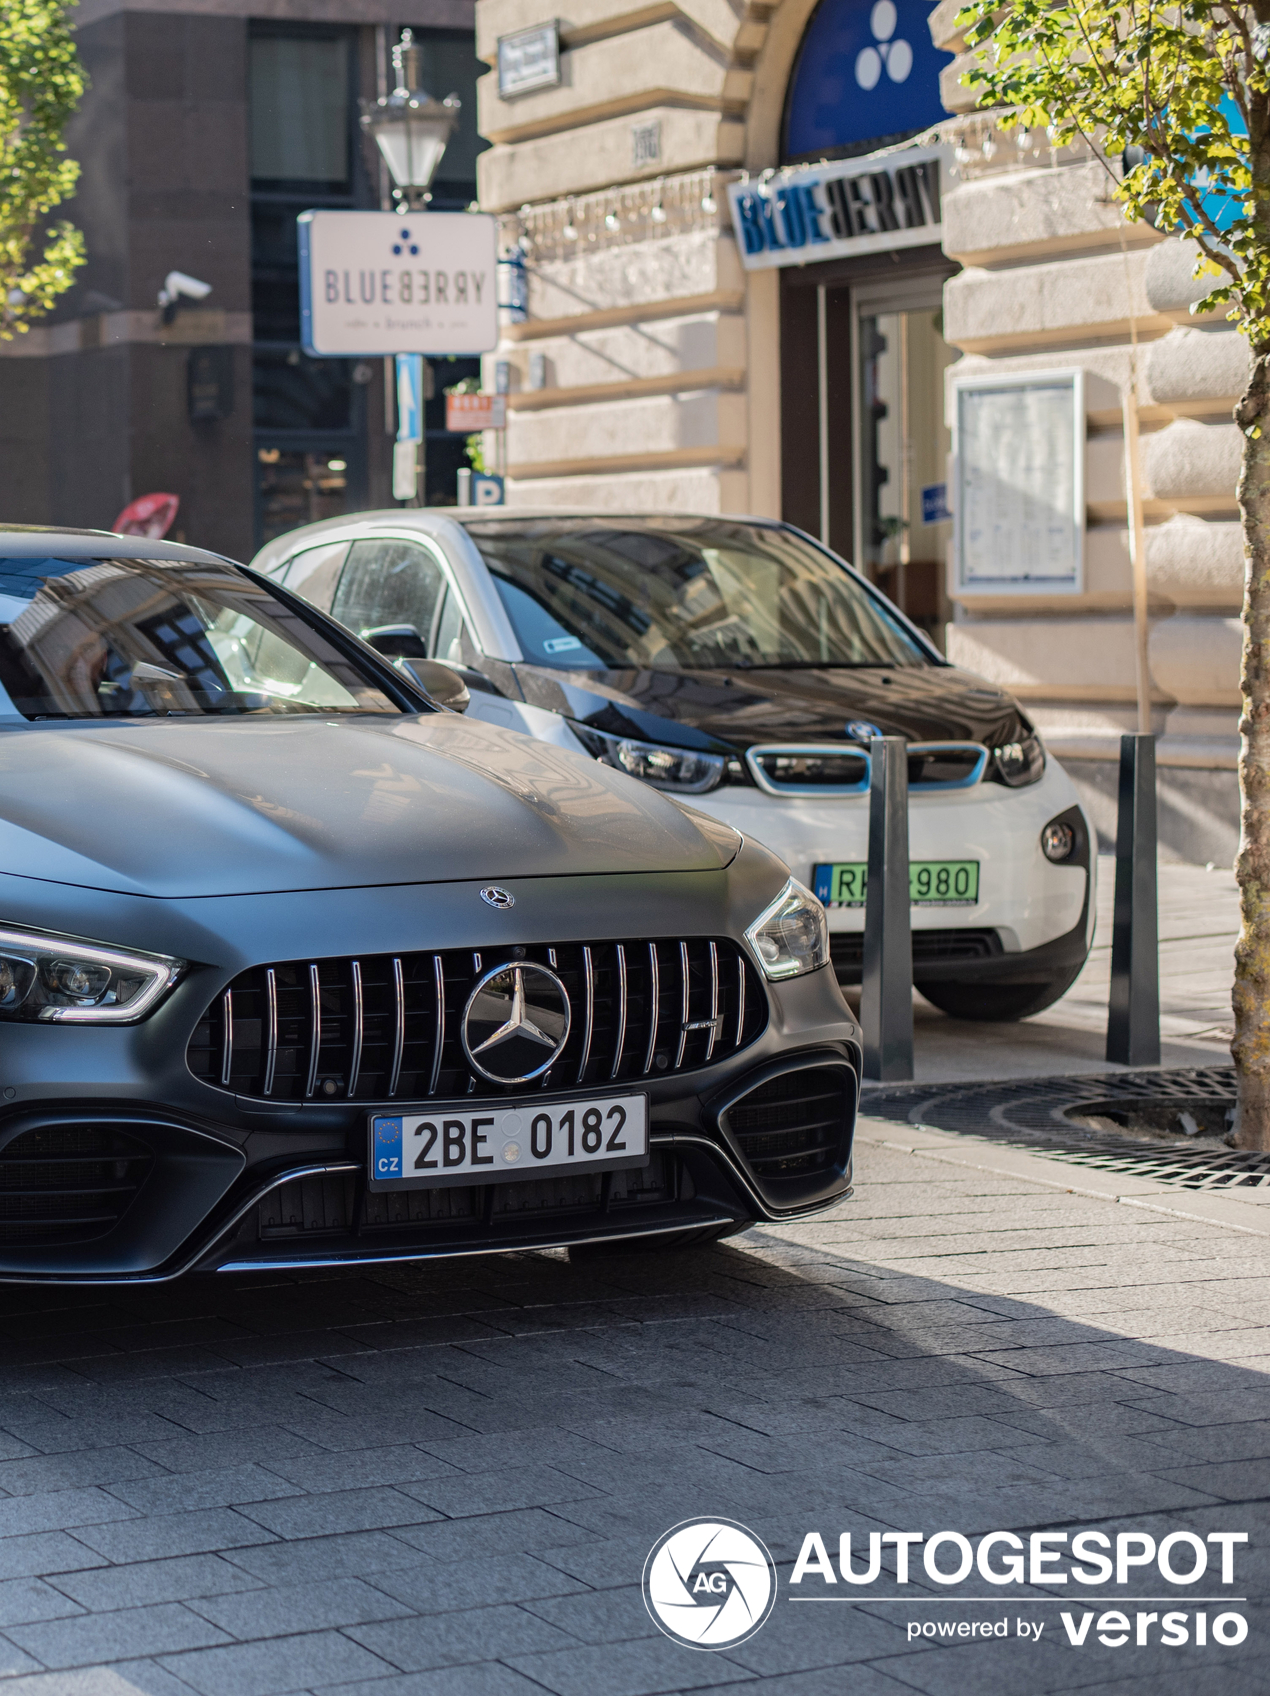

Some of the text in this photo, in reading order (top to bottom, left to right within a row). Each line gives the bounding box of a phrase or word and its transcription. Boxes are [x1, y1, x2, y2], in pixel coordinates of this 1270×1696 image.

[475, 480, 502, 506] P
[414, 1104, 628, 1170] 2BE 0182
[378, 1157, 399, 1173] CZ
